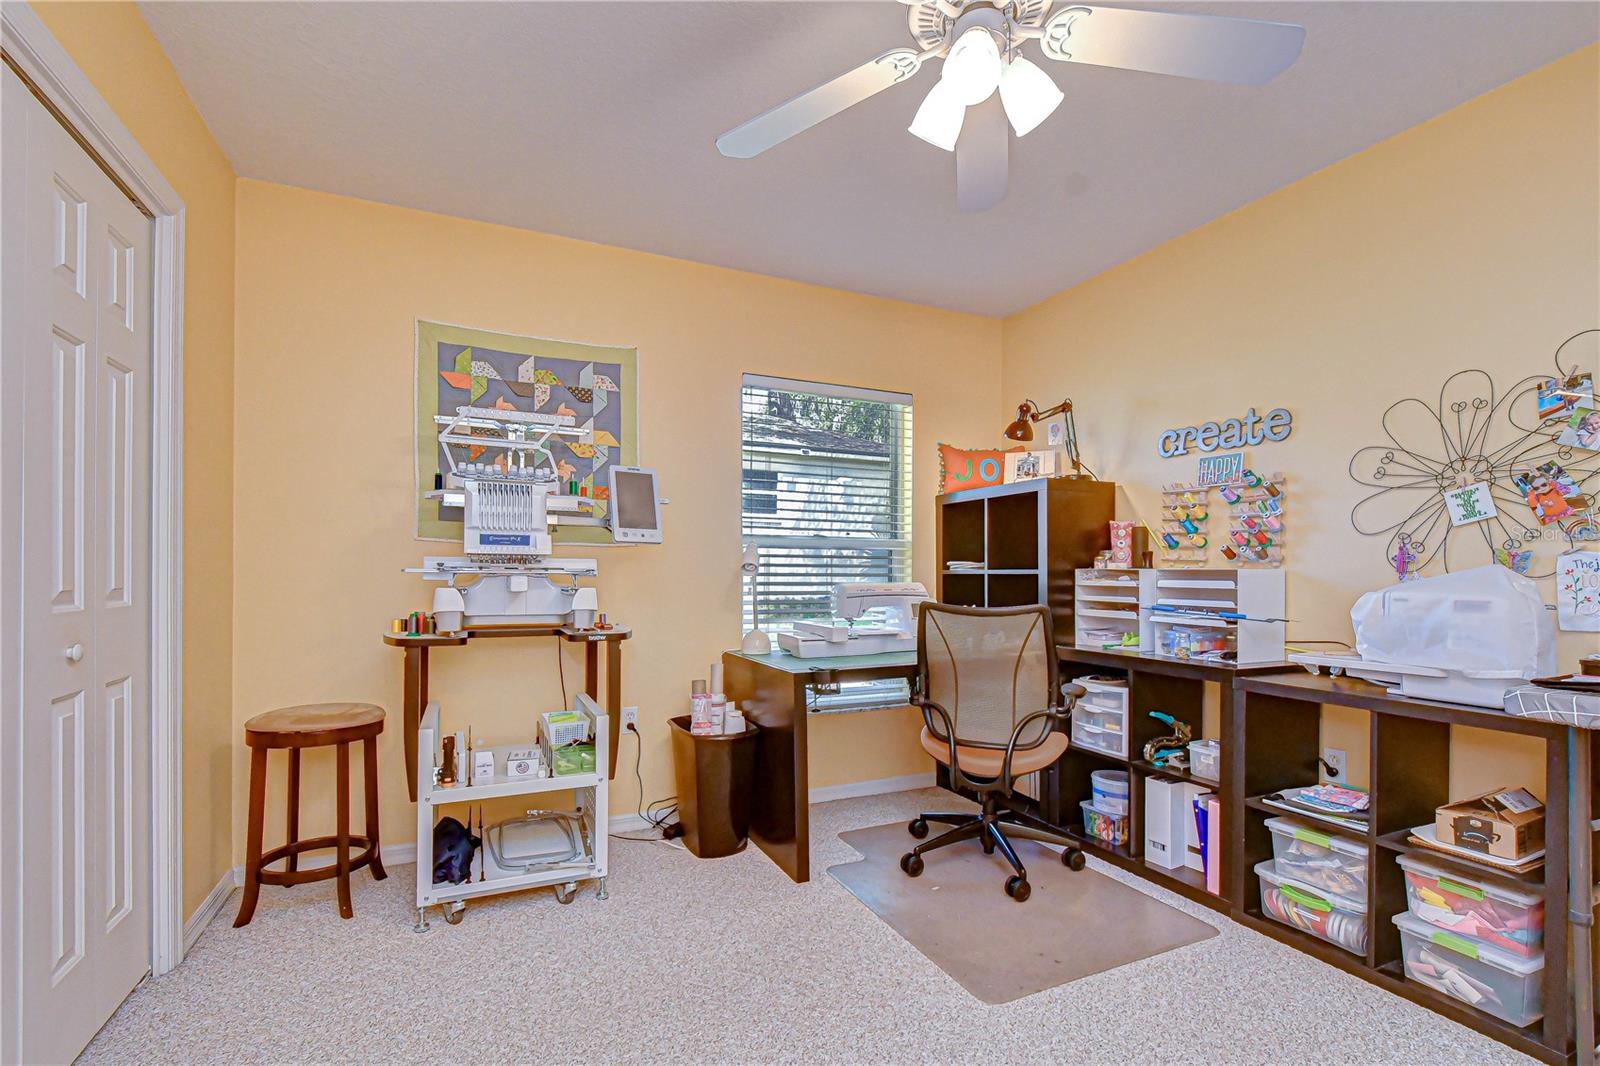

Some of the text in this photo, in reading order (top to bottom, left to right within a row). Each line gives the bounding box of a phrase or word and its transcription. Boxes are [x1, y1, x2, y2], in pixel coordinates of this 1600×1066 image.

[1158, 407, 1292, 458] create
[1200, 456, 1240, 484] HAPPY
[1573, 559, 1594, 569] The
